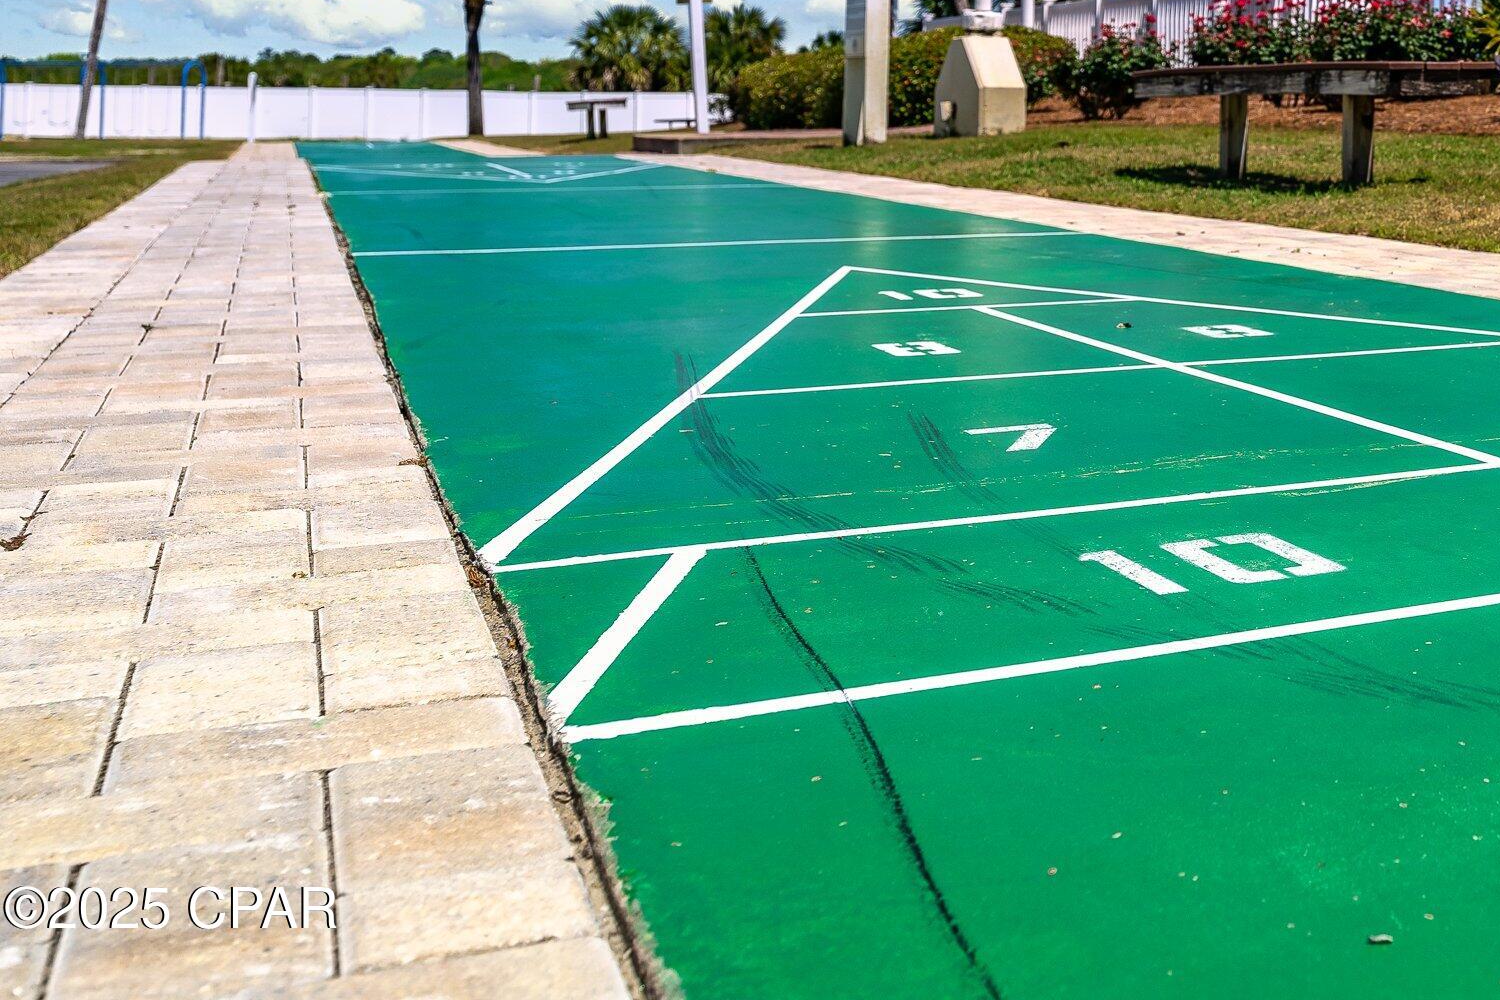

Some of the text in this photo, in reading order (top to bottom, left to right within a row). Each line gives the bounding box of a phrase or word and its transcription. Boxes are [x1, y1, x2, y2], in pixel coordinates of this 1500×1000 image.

[878, 288, 984, 300] 10
[1182, 324, 1274, 339] 8
[871, 341, 962, 357] 8
[963, 423, 1058, 452] 7
[1079, 532, 1347, 596] 10
